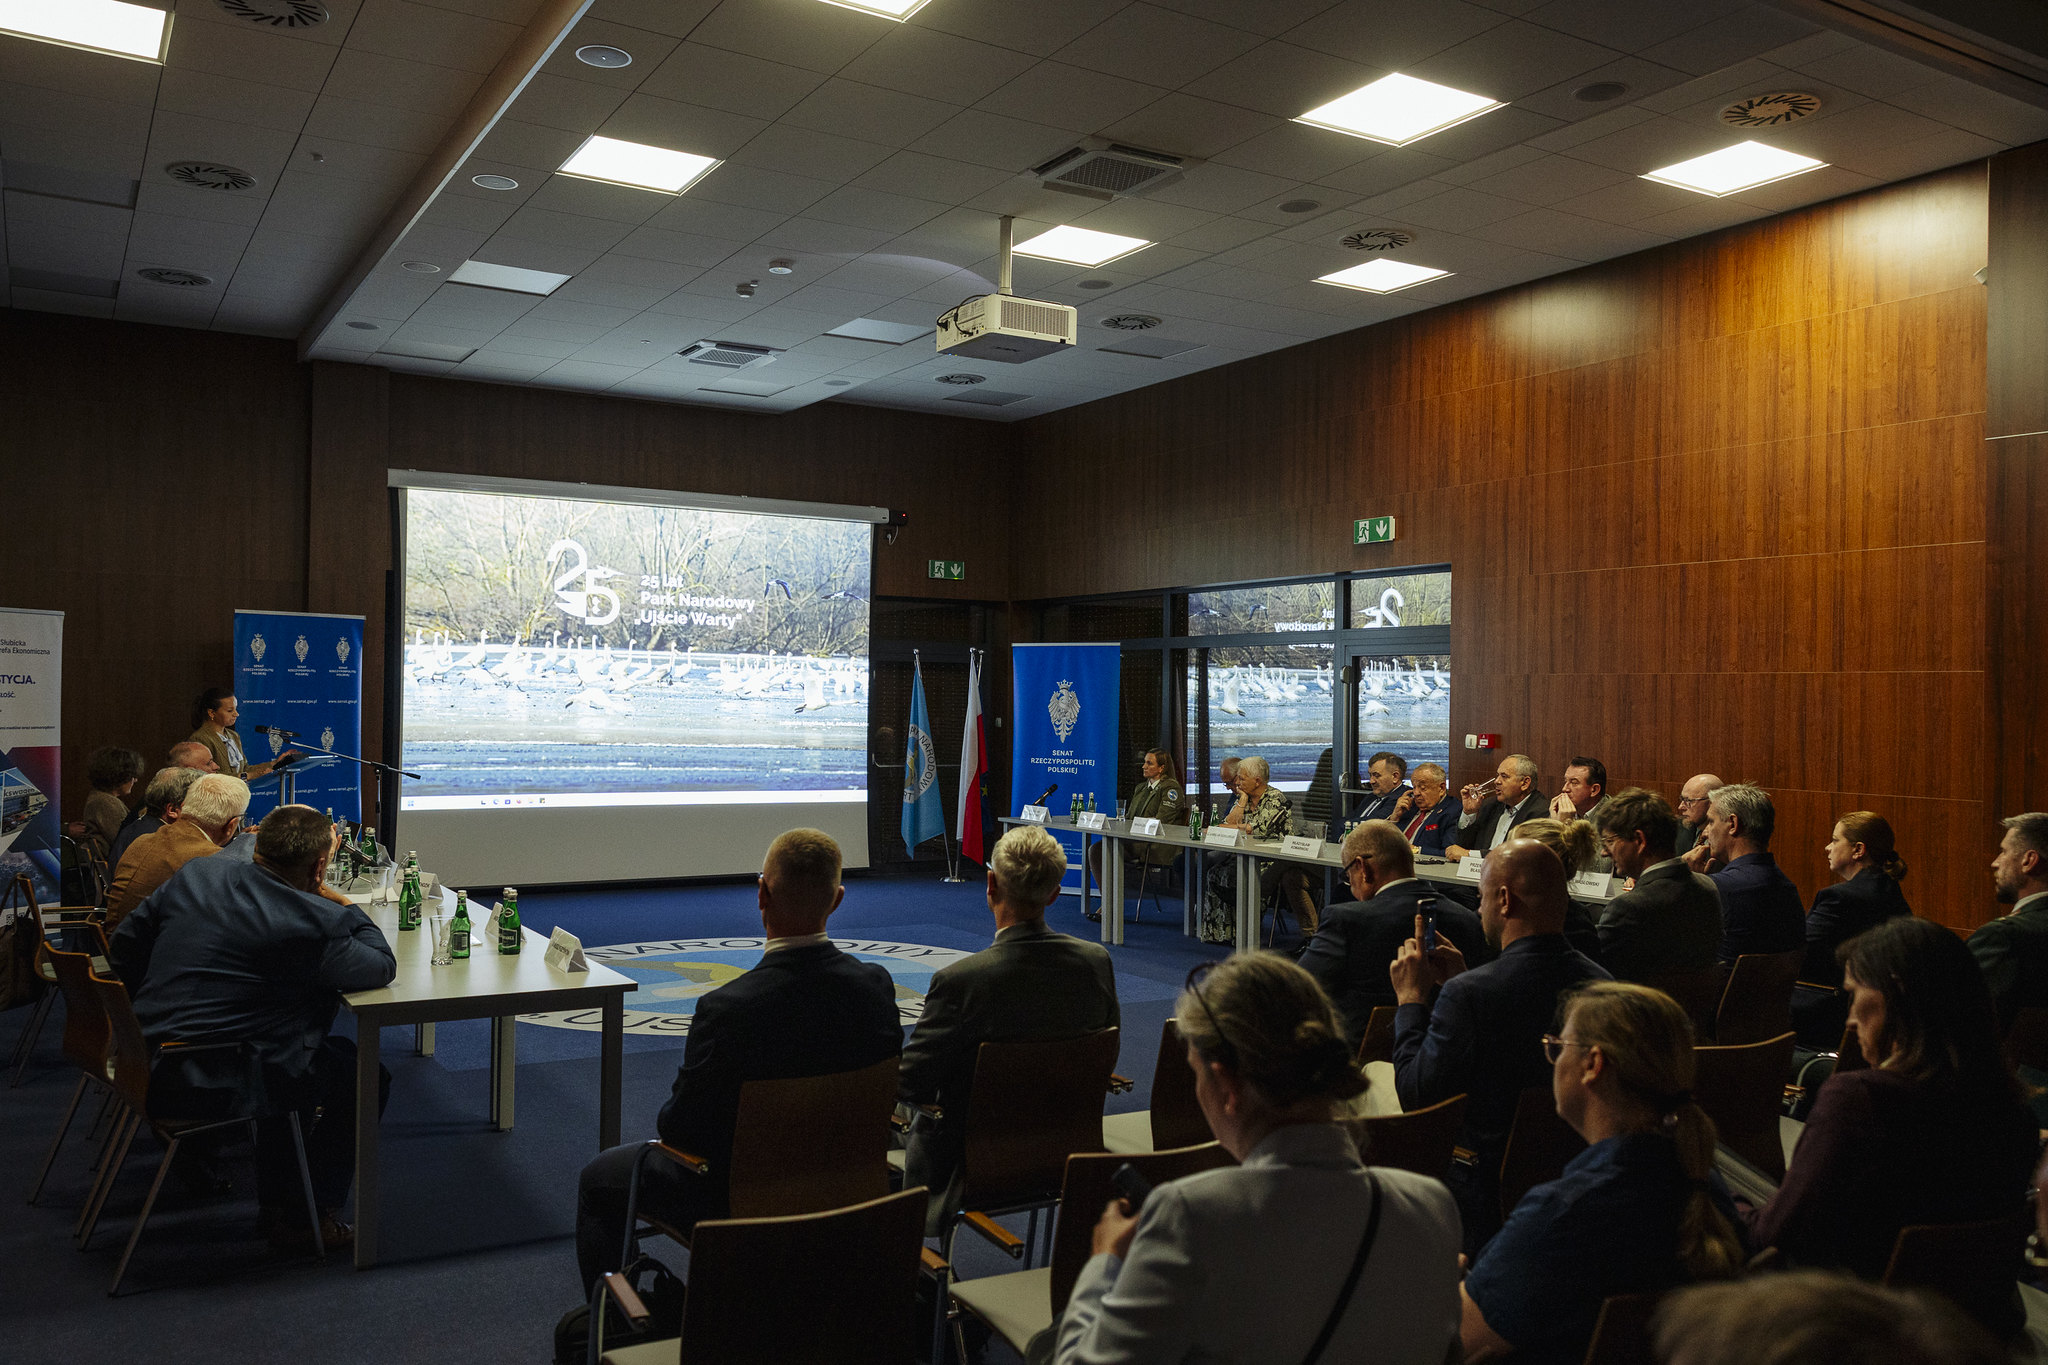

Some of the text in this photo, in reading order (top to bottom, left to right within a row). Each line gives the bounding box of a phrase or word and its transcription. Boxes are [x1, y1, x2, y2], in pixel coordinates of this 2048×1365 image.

[641, 575, 659, 589] 25
[641, 591, 756, 613] Park Narodowy
[1, 638, 26, 646] Słubicka
[13, 647, 50, 656] Ekonomiczna
[0, 674, 36, 685] TYCJA.
[1052, 749, 1075, 757] SENAT
[1030, 757, 1096, 767] RZECZYPOSPOLITEJ
[1047, 766, 1078, 775] POLSKIEJ
[584, 939, 958, 958] NAROOWY
